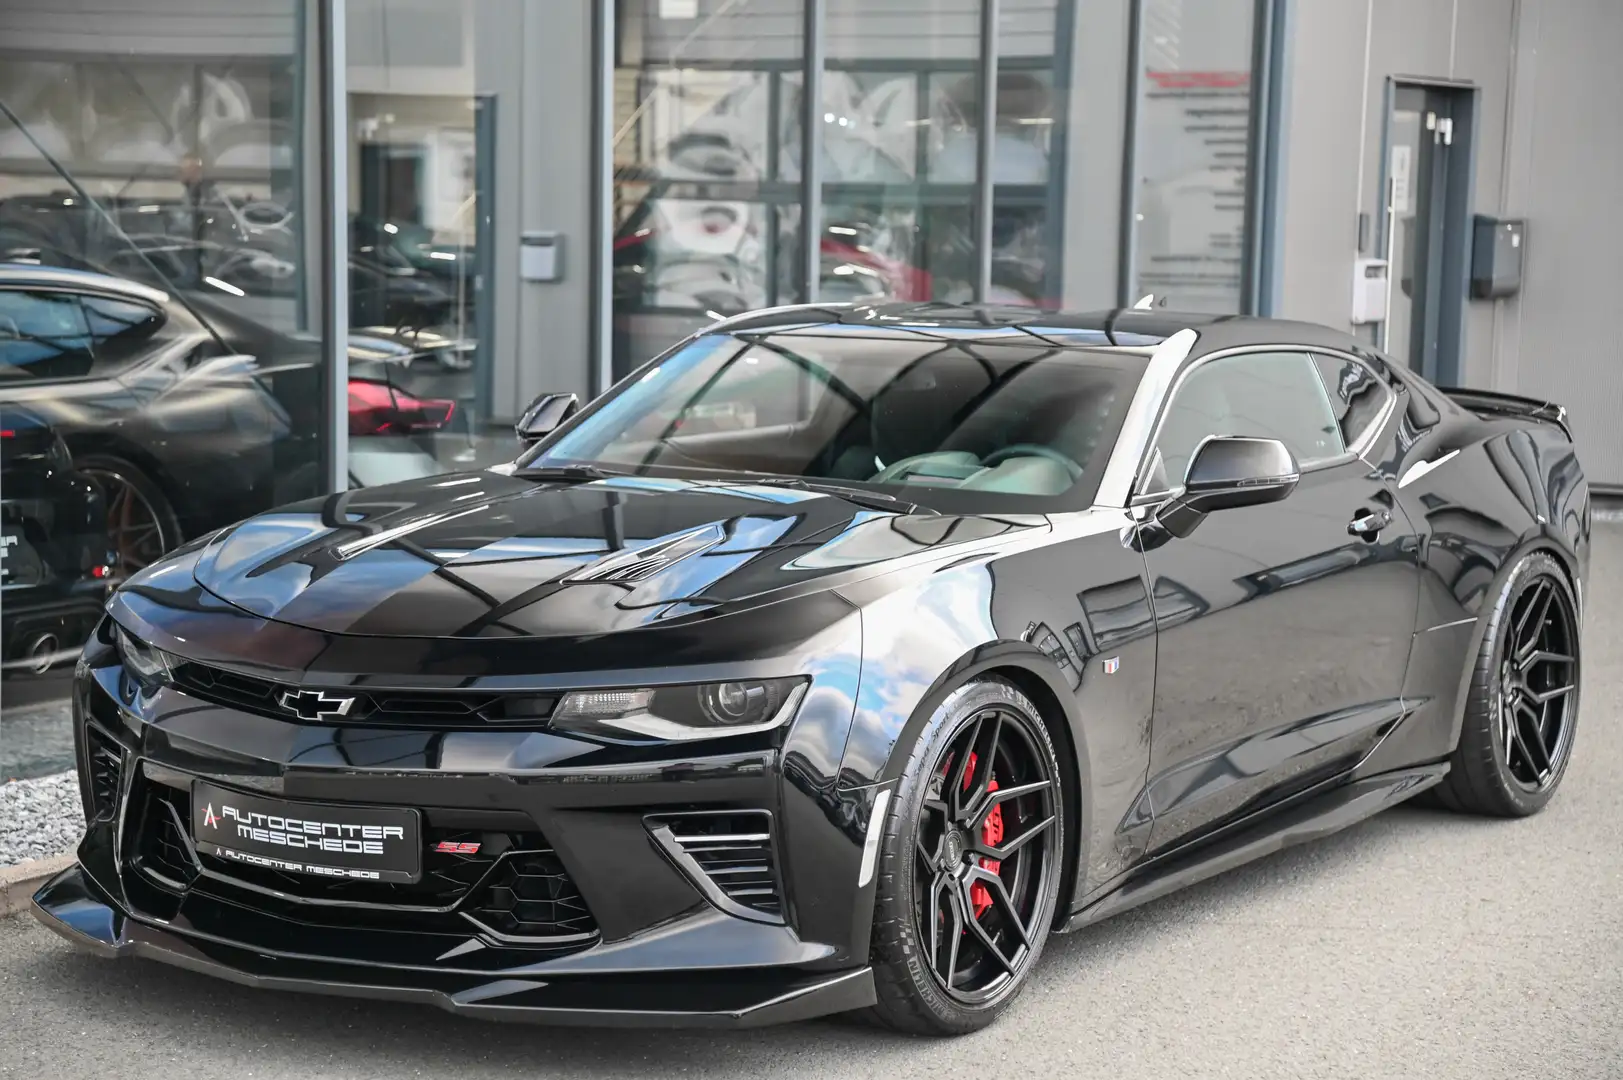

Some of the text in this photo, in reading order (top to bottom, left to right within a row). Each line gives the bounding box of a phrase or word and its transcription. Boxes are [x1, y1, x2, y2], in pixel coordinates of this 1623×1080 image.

[222, 805, 404, 840] AUTOCENTER
[237, 824, 384, 855] MESCHEDE
[433, 841, 482, 854] SS
[225, 850, 302, 872] AUTOCENTER
[306, 865, 380, 879] MESCHEDE
